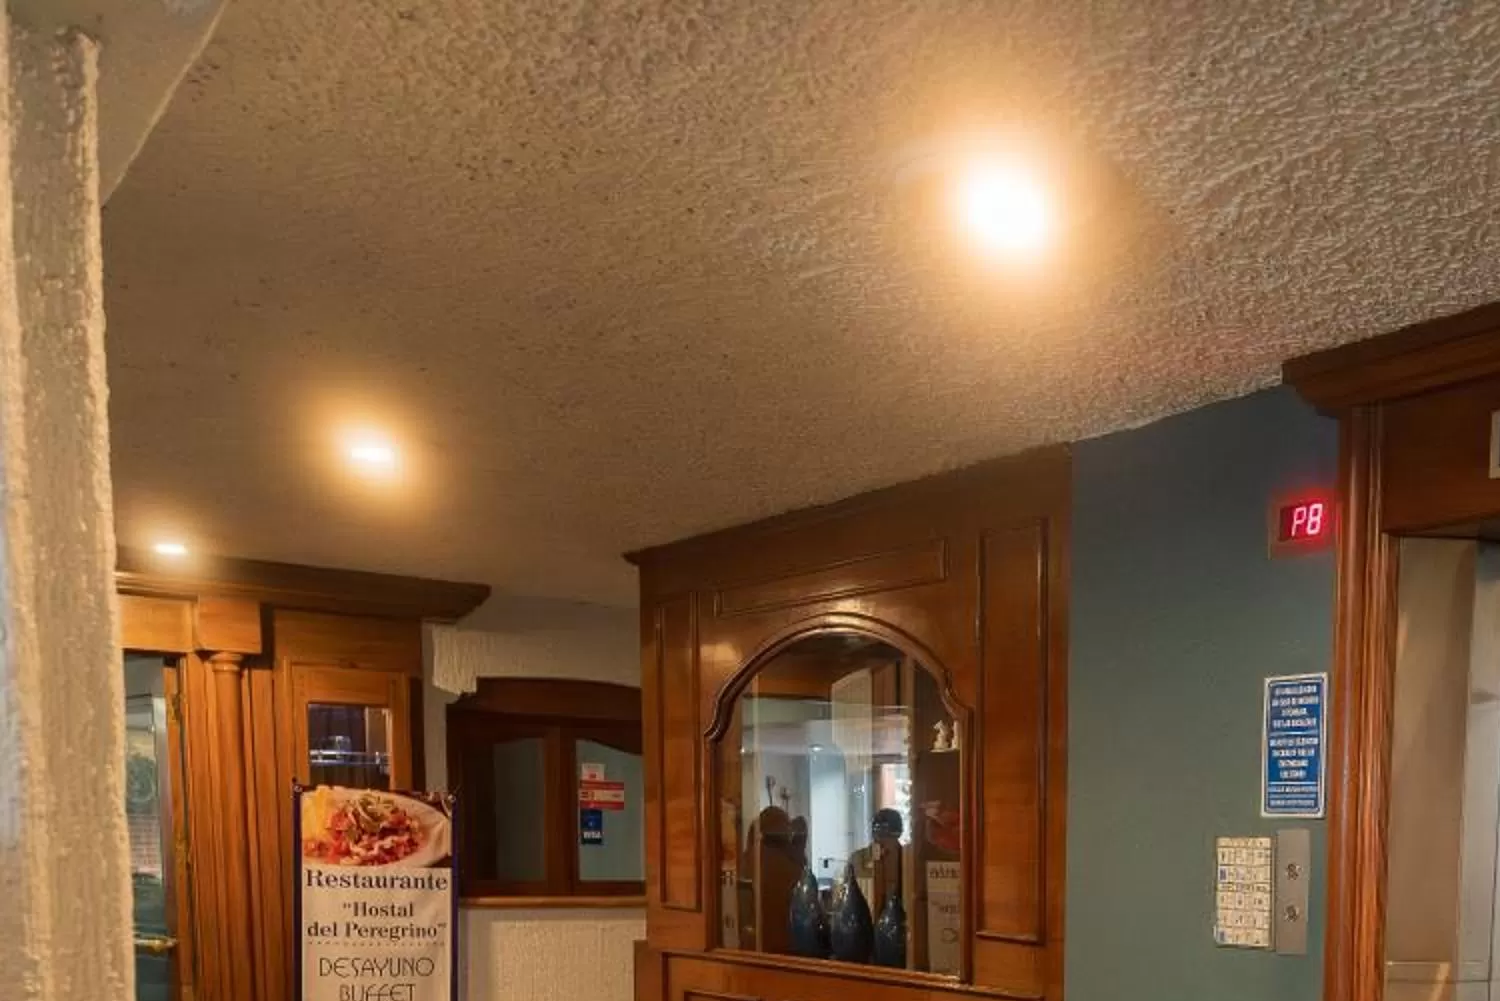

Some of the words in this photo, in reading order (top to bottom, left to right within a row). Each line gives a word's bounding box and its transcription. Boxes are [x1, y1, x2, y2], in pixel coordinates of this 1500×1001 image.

[306, 869, 448, 891] Restaurante
[307, 921, 338, 937] del
[319, 957, 435, 978] DESAYUNO
